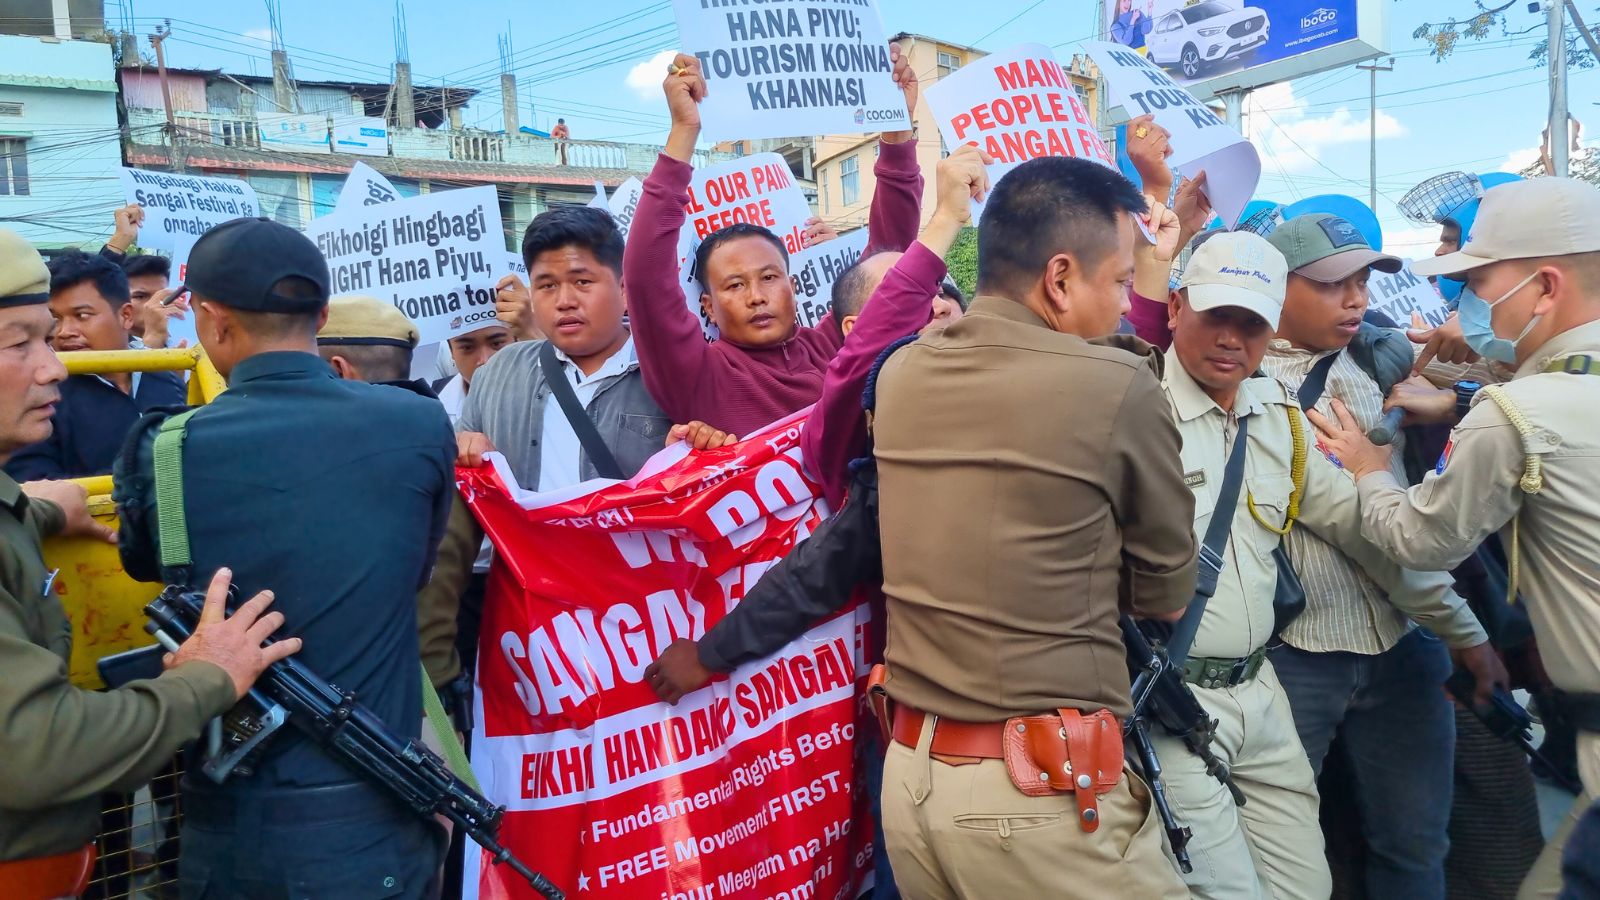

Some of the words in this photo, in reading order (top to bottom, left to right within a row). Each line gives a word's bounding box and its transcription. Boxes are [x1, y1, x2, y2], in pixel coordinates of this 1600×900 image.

[726, 8, 803, 42] HANA
[807, 8, 862, 45] PIYU;
[1300, 11, 1336, 28] IboGo
[695, 43, 817, 81] TOURISM
[821, 43, 892, 73] KONNA
[1107, 50, 1156, 69] HIN
[747, 78, 867, 111] KHANNASI
[1129, 88, 1202, 115] TOUR
[866, 109, 905, 120] COCOMI
[951, 93, 1069, 140] PEOPLE
[1184, 108, 1226, 129] KH
[967, 127, 1076, 164] ANGAI
[135, 188, 188, 213] Sangai
[191, 192, 239, 215] Festival
[705, 171, 752, 208] OUR
[751, 163, 791, 195] PAIN
[317, 220, 388, 259] Eikhoigi
[392, 204, 487, 247] Hingbagi
[331, 260, 372, 295] IGHT
[378, 256, 431, 286] Hana
[434, 247, 492, 281] Piyu,
[1219, 266, 1250, 277] Manipur
[1251, 269, 1271, 283] Police
[393, 289, 462, 319] konna
[466, 284, 498, 306] tou
[464, 310, 497, 323] COCO
[592, 774, 734, 843] Fundamental
[732, 748, 796, 787] Rights
[796, 722, 854, 758] Befo
[598, 846, 670, 889] FREE
[673, 804, 769, 863] Movement
[718, 852, 785, 897] Meeyam
[788, 838, 821, 866] na
